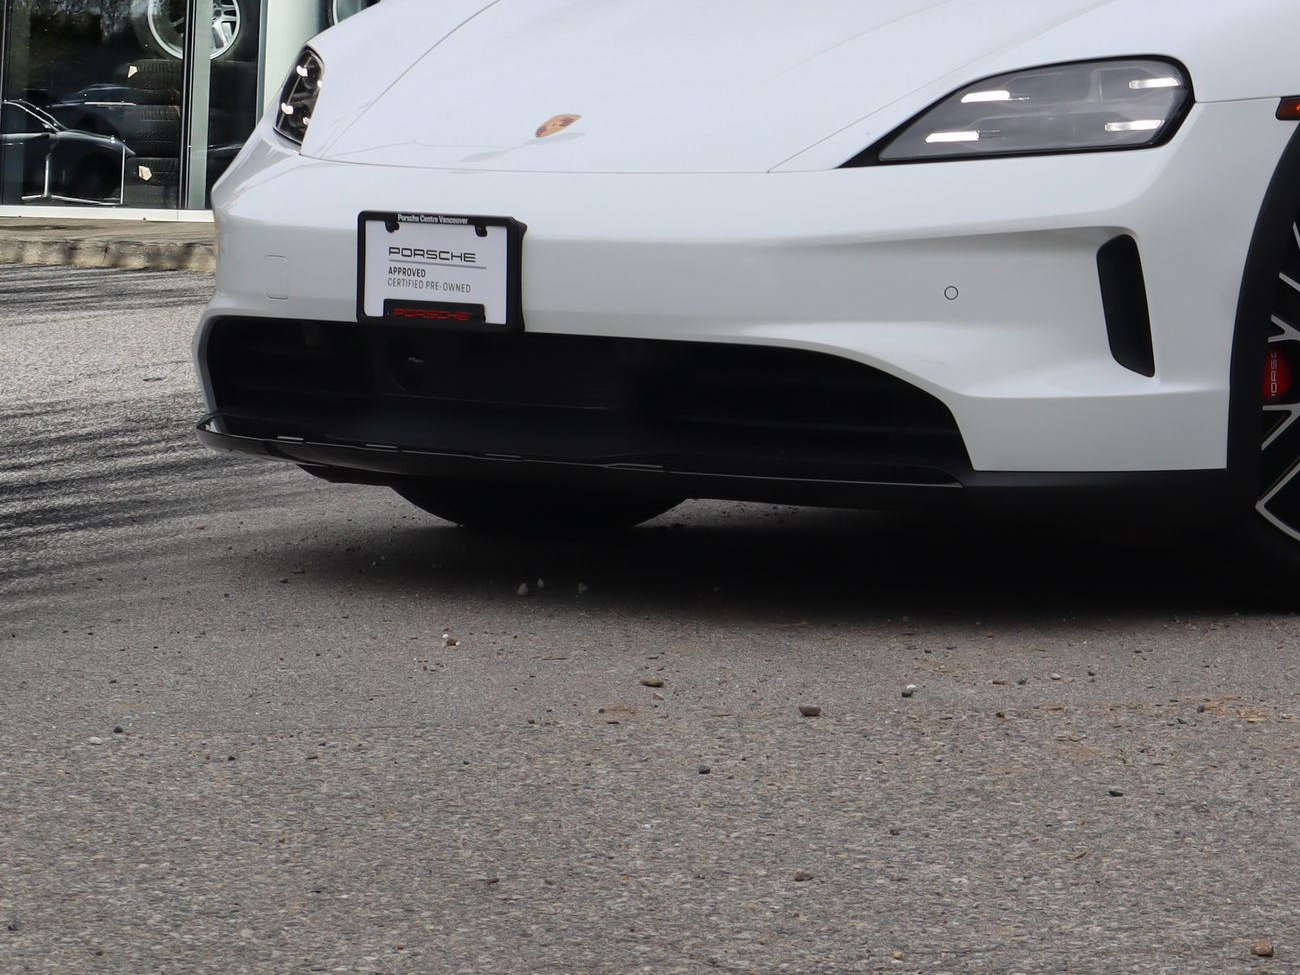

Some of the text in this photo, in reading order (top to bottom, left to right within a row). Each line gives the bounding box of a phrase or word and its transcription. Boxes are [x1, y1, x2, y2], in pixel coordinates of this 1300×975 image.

[397, 213, 468, 225] Porsche Centre Vancouver
[388, 246, 477, 263] PORSCHE
[388, 266, 426, 278] APPROVED
[387, 277, 471, 293] CERTIFIED PRE-OWNED
[393, 308, 471, 321] PORSCHE
